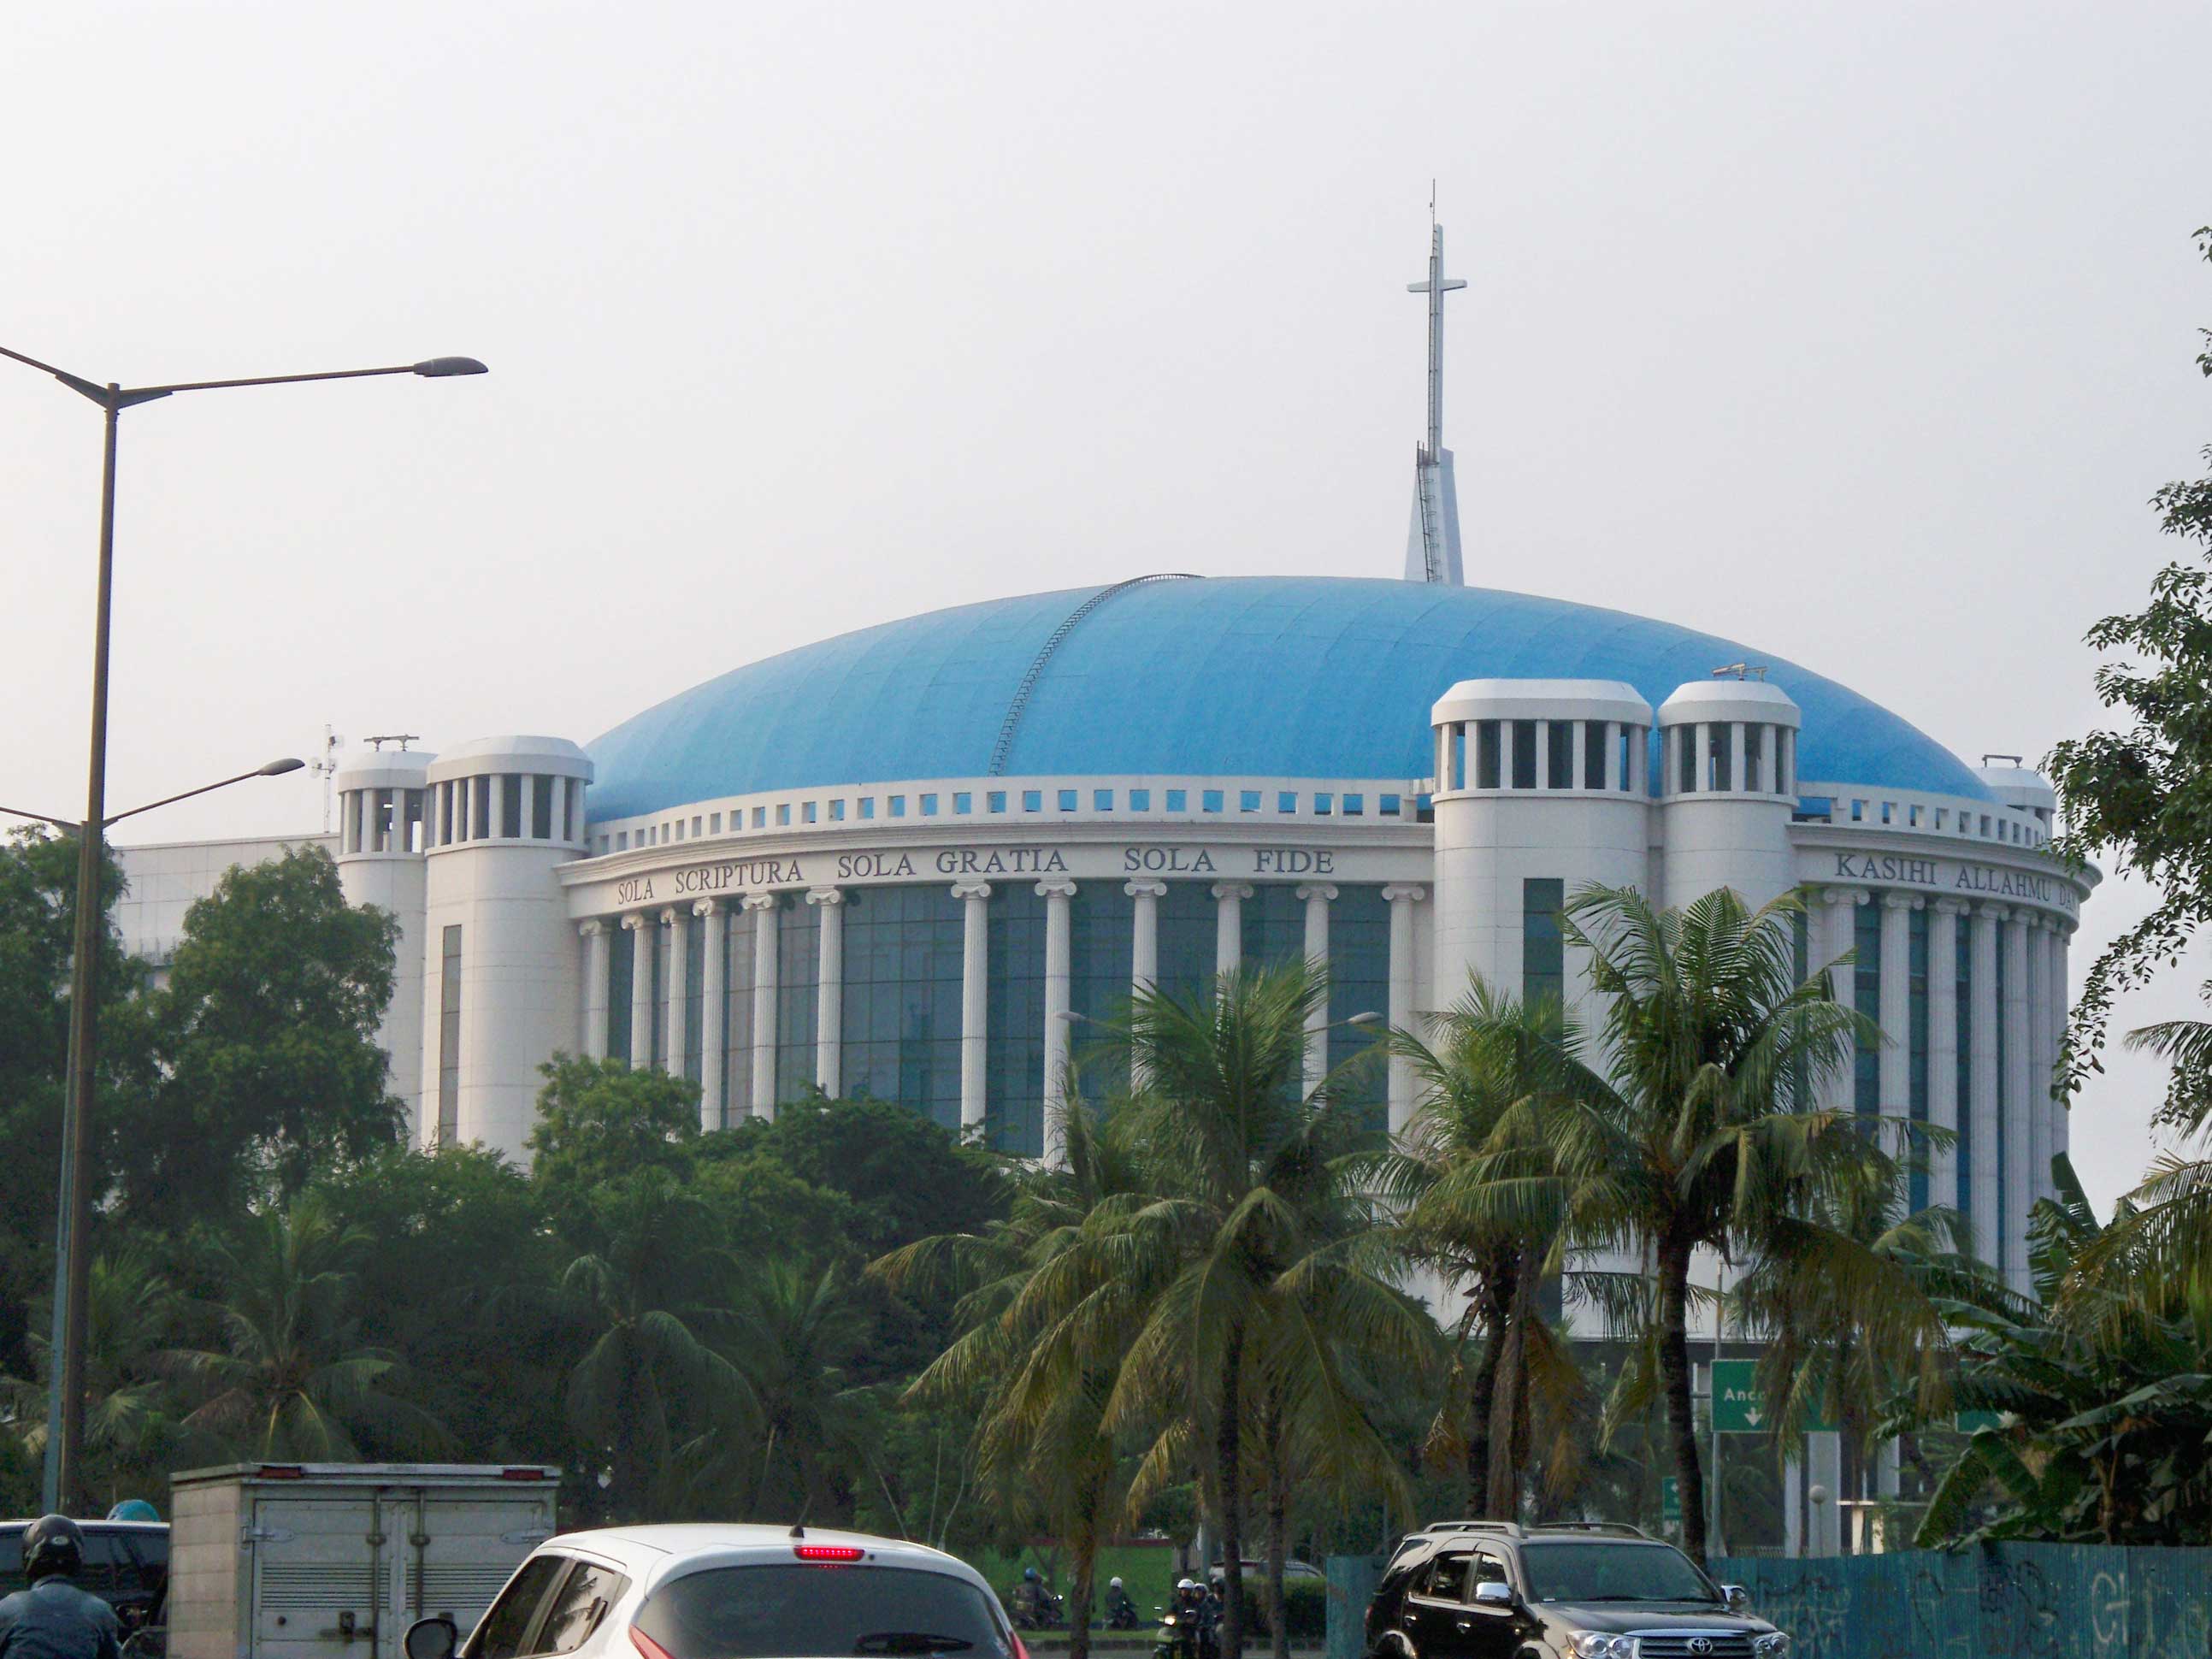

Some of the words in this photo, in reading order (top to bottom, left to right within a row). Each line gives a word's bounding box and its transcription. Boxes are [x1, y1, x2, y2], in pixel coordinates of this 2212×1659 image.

[618, 877, 655, 906] SOLA
[675, 860, 804, 894] SCRIPTURA
[837, 853, 917, 878] SOLA
[935, 848, 1069, 874] GRATIA
[1124, 847, 1217, 872] SOLA
[1253, 848, 1335, 874] FIDE
[1835, 853, 1937, 886] KASIHI
[1955, 865, 2050, 902] ALLAHMU
